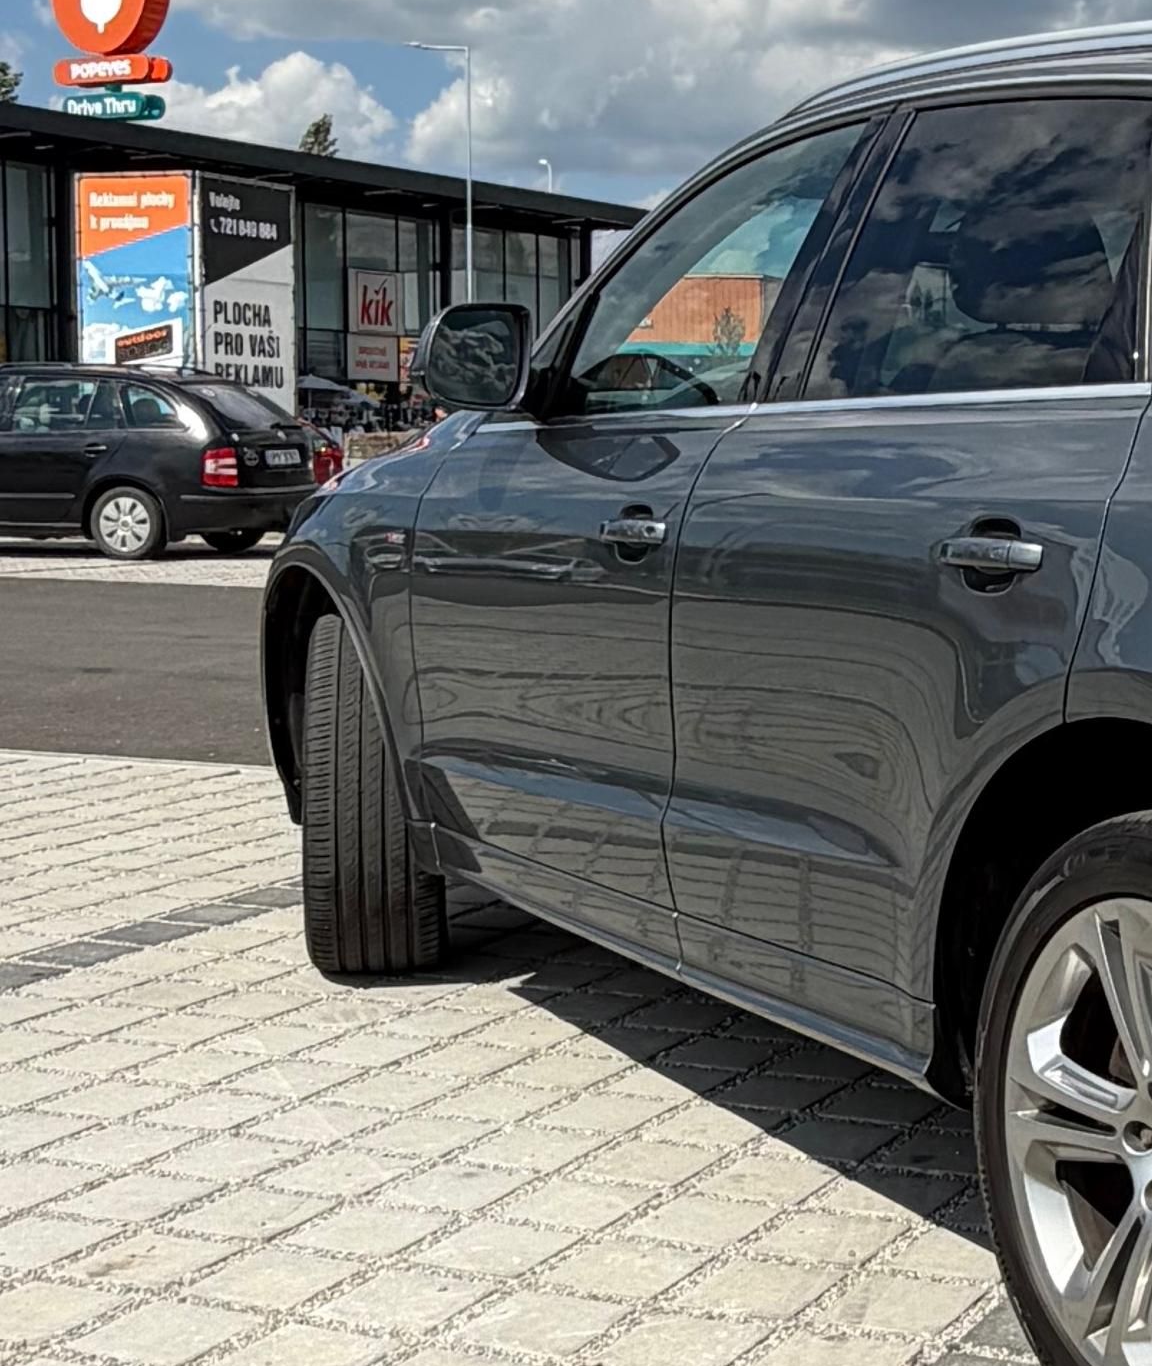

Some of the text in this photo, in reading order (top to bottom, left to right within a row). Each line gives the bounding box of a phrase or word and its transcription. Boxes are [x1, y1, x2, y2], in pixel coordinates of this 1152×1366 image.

[70, 59, 131, 80] POPEYES
[67, 97, 137, 115] Drive Thru
[213, 299, 272, 328] PLOCHA
[214, 331, 244, 357] PRO
